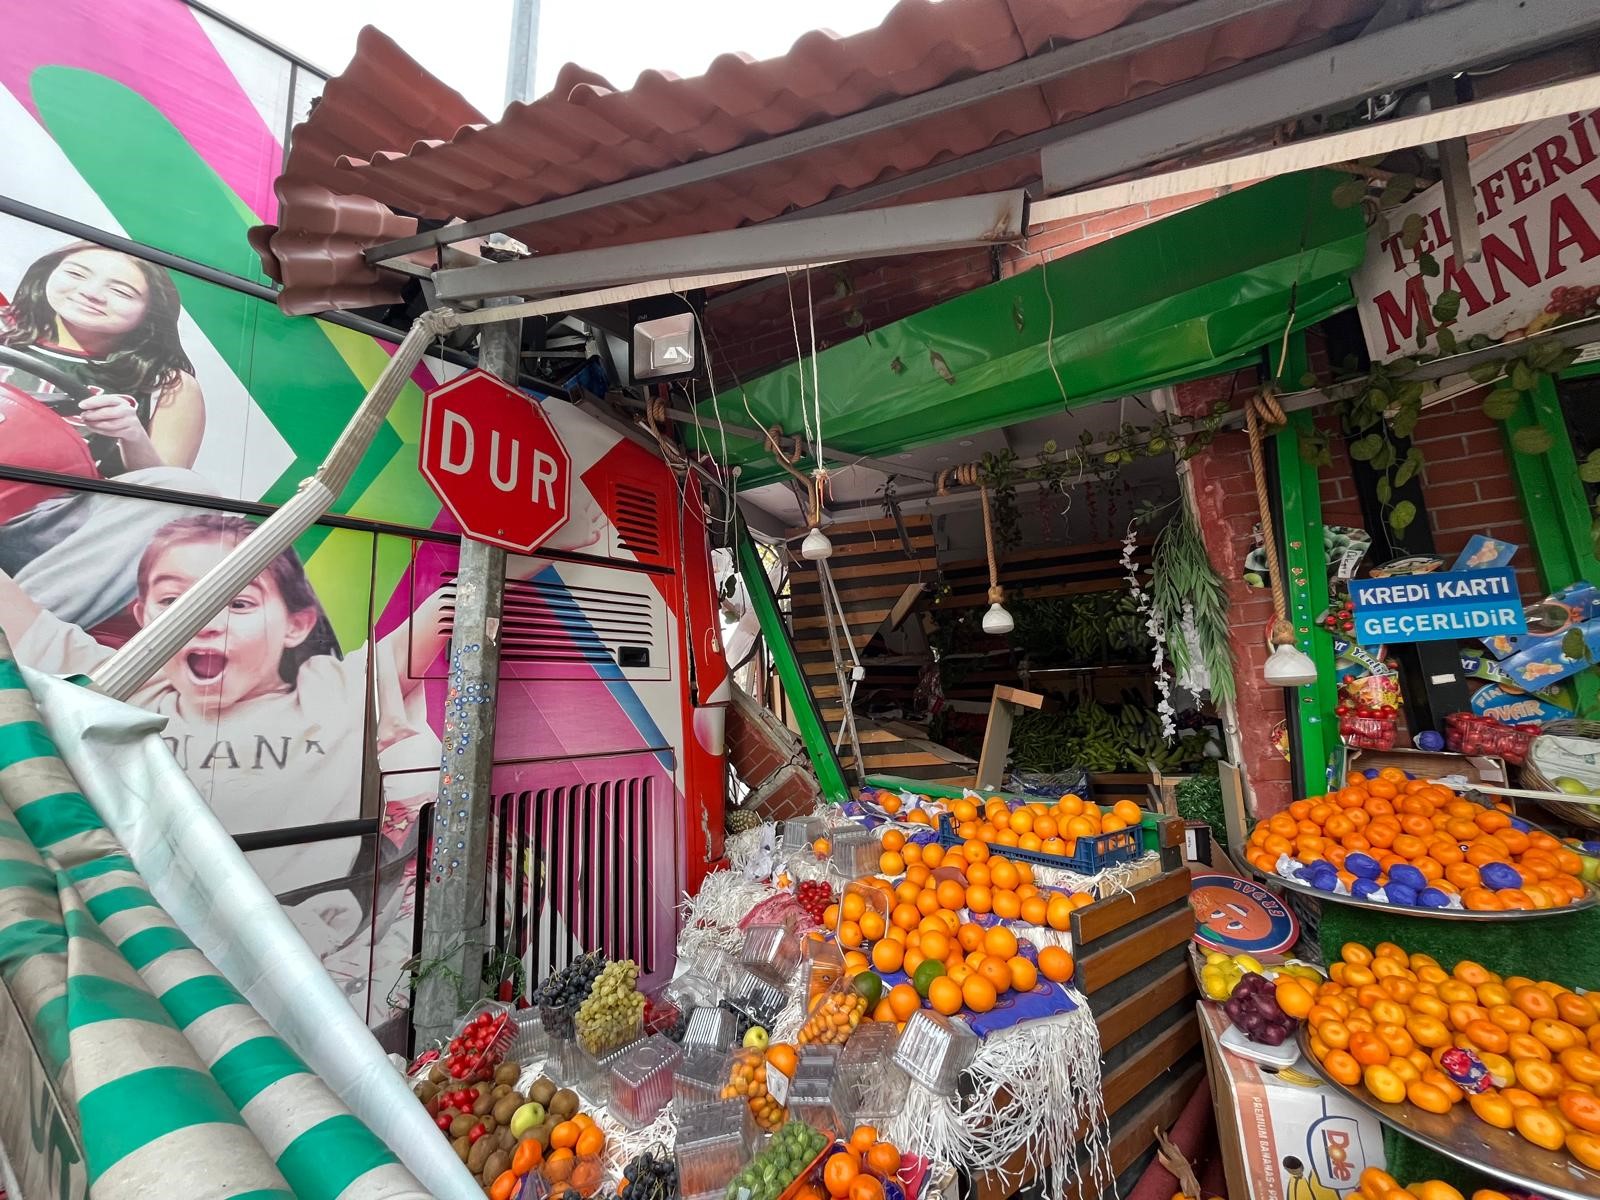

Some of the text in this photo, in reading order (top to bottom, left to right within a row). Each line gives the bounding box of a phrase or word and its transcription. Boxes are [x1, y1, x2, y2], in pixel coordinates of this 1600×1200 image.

[440, 408, 558, 510] DUR
[1436, 576, 1509, 599] KARTI
[1326, 1129, 1356, 1182] Dole
